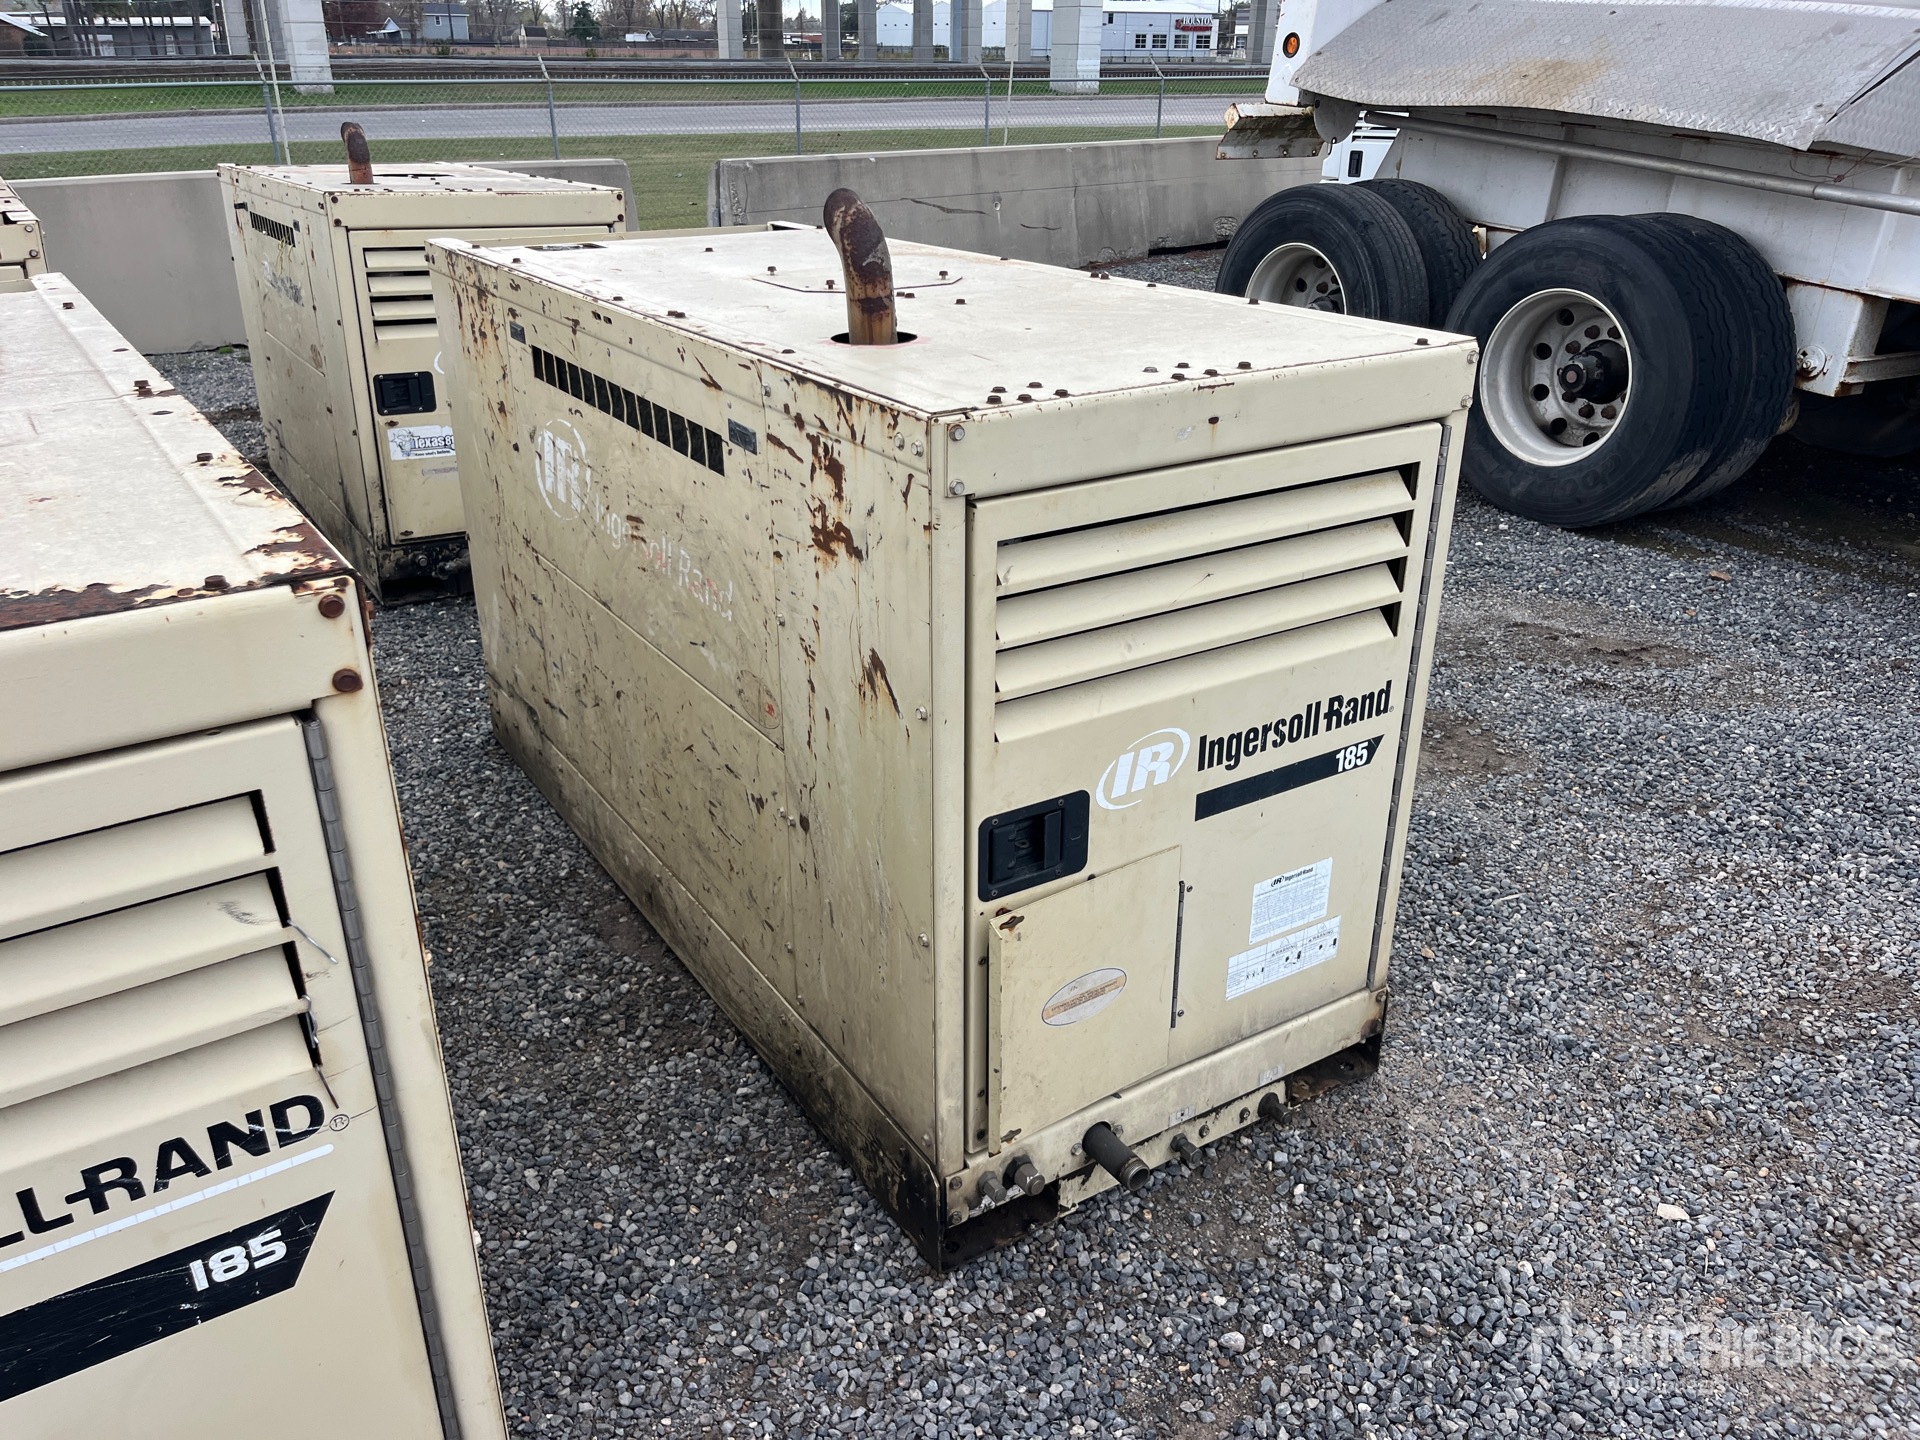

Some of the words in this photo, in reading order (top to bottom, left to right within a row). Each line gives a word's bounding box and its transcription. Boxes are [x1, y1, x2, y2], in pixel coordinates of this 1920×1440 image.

[1182, 15, 1214, 25] HOUSTON
[413, 436, 445, 449] Texas
[1108, 738, 1178, 801] IR
[1335, 741, 1369, 773] 185
[189, 1228, 288, 1292] 185
